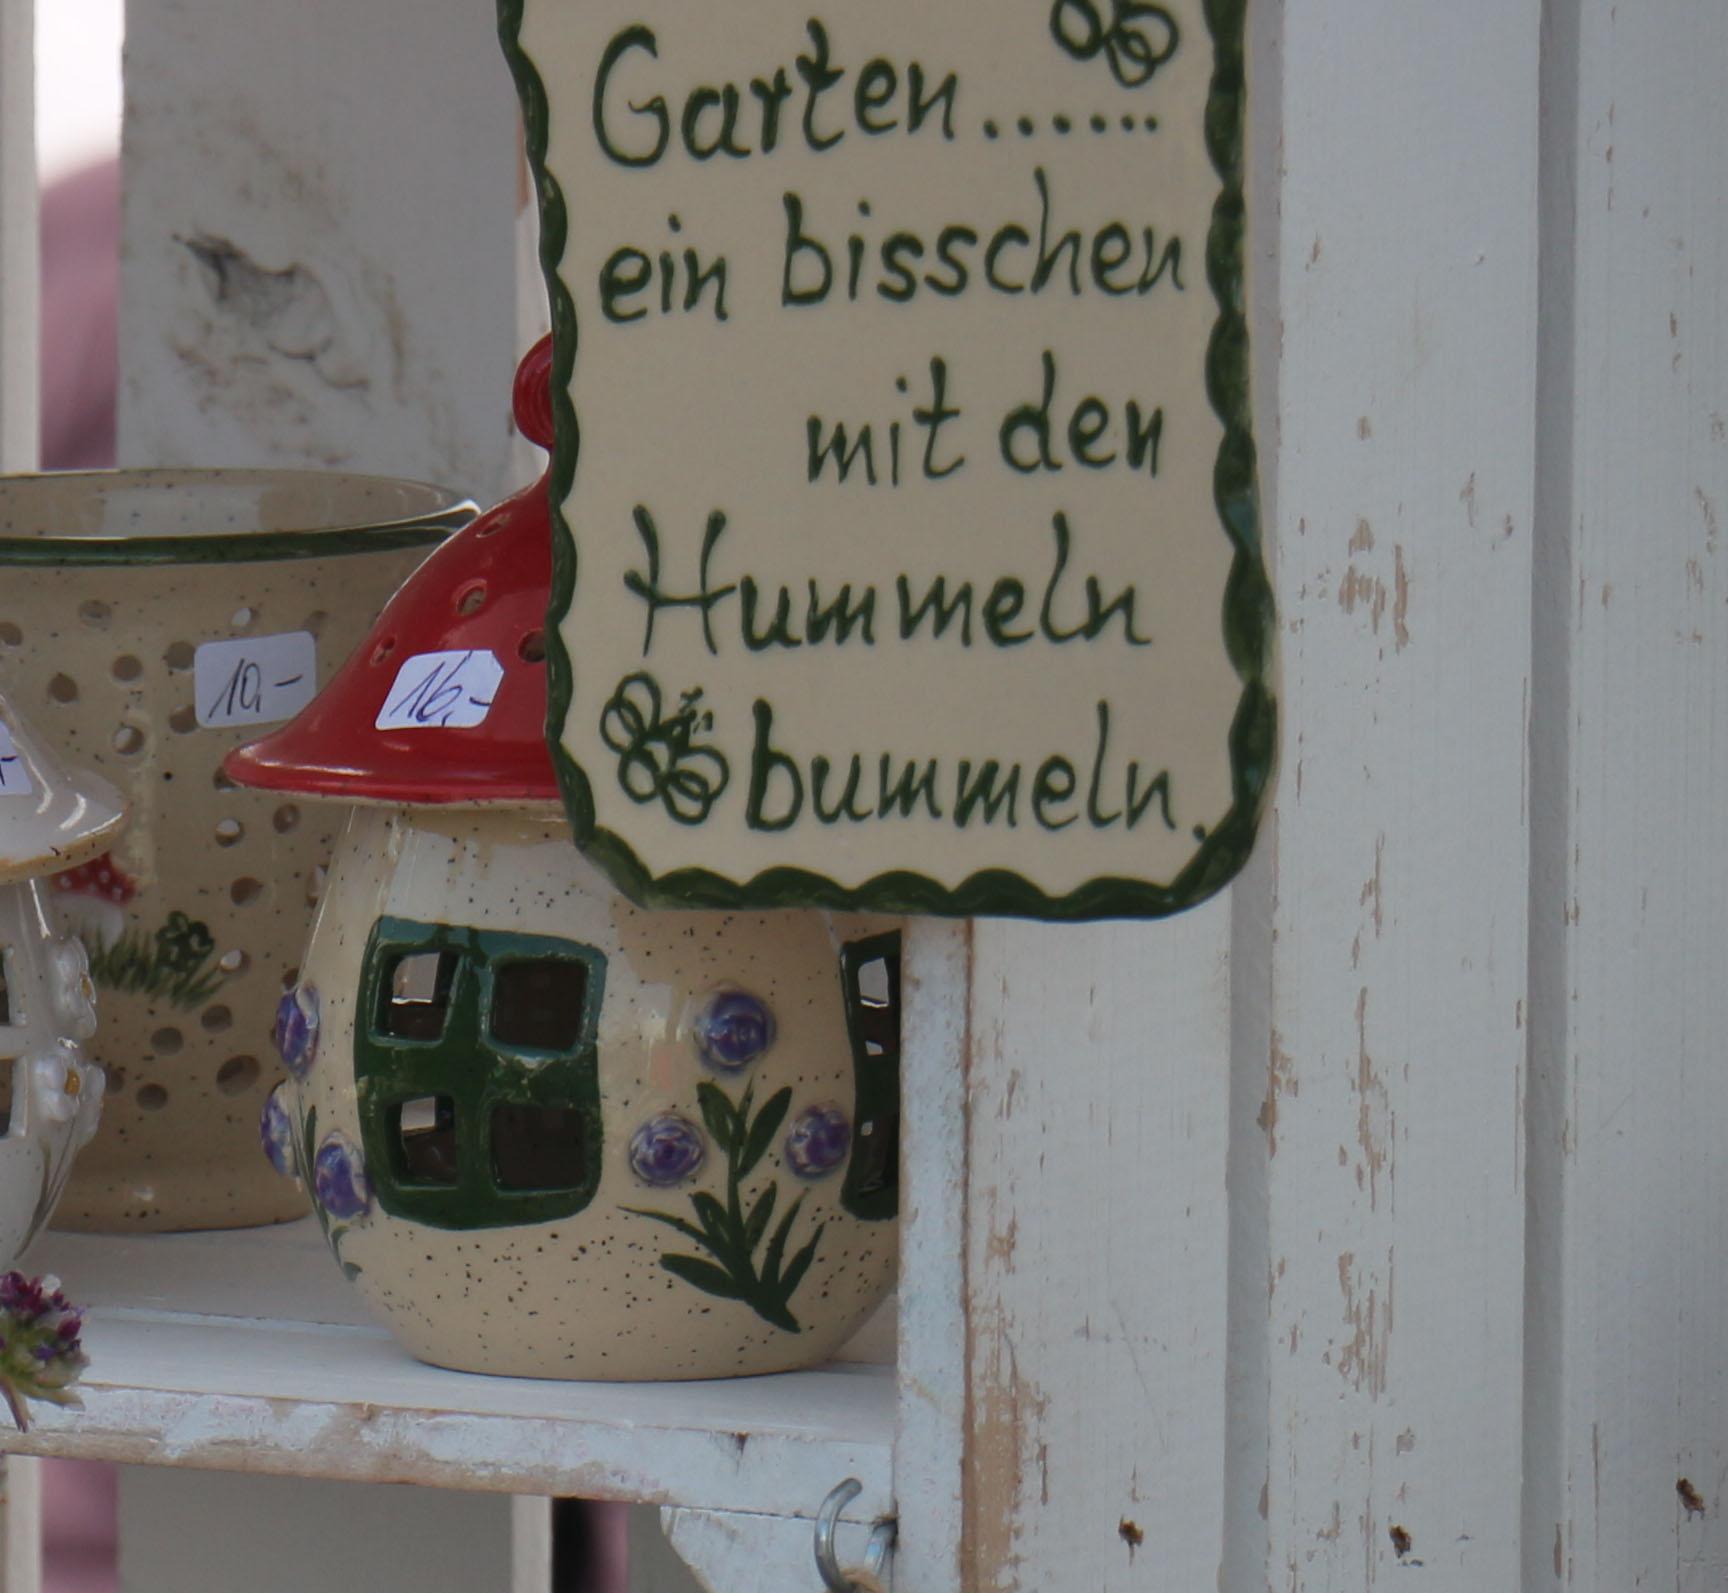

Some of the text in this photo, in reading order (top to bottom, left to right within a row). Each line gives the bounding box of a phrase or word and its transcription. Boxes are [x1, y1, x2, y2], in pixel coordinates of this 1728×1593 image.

[599, 165, 1185, 322] ein bisschen
[807, 350, 1163, 485] mit den
[625, 504, 1152, 656] Hummeln
